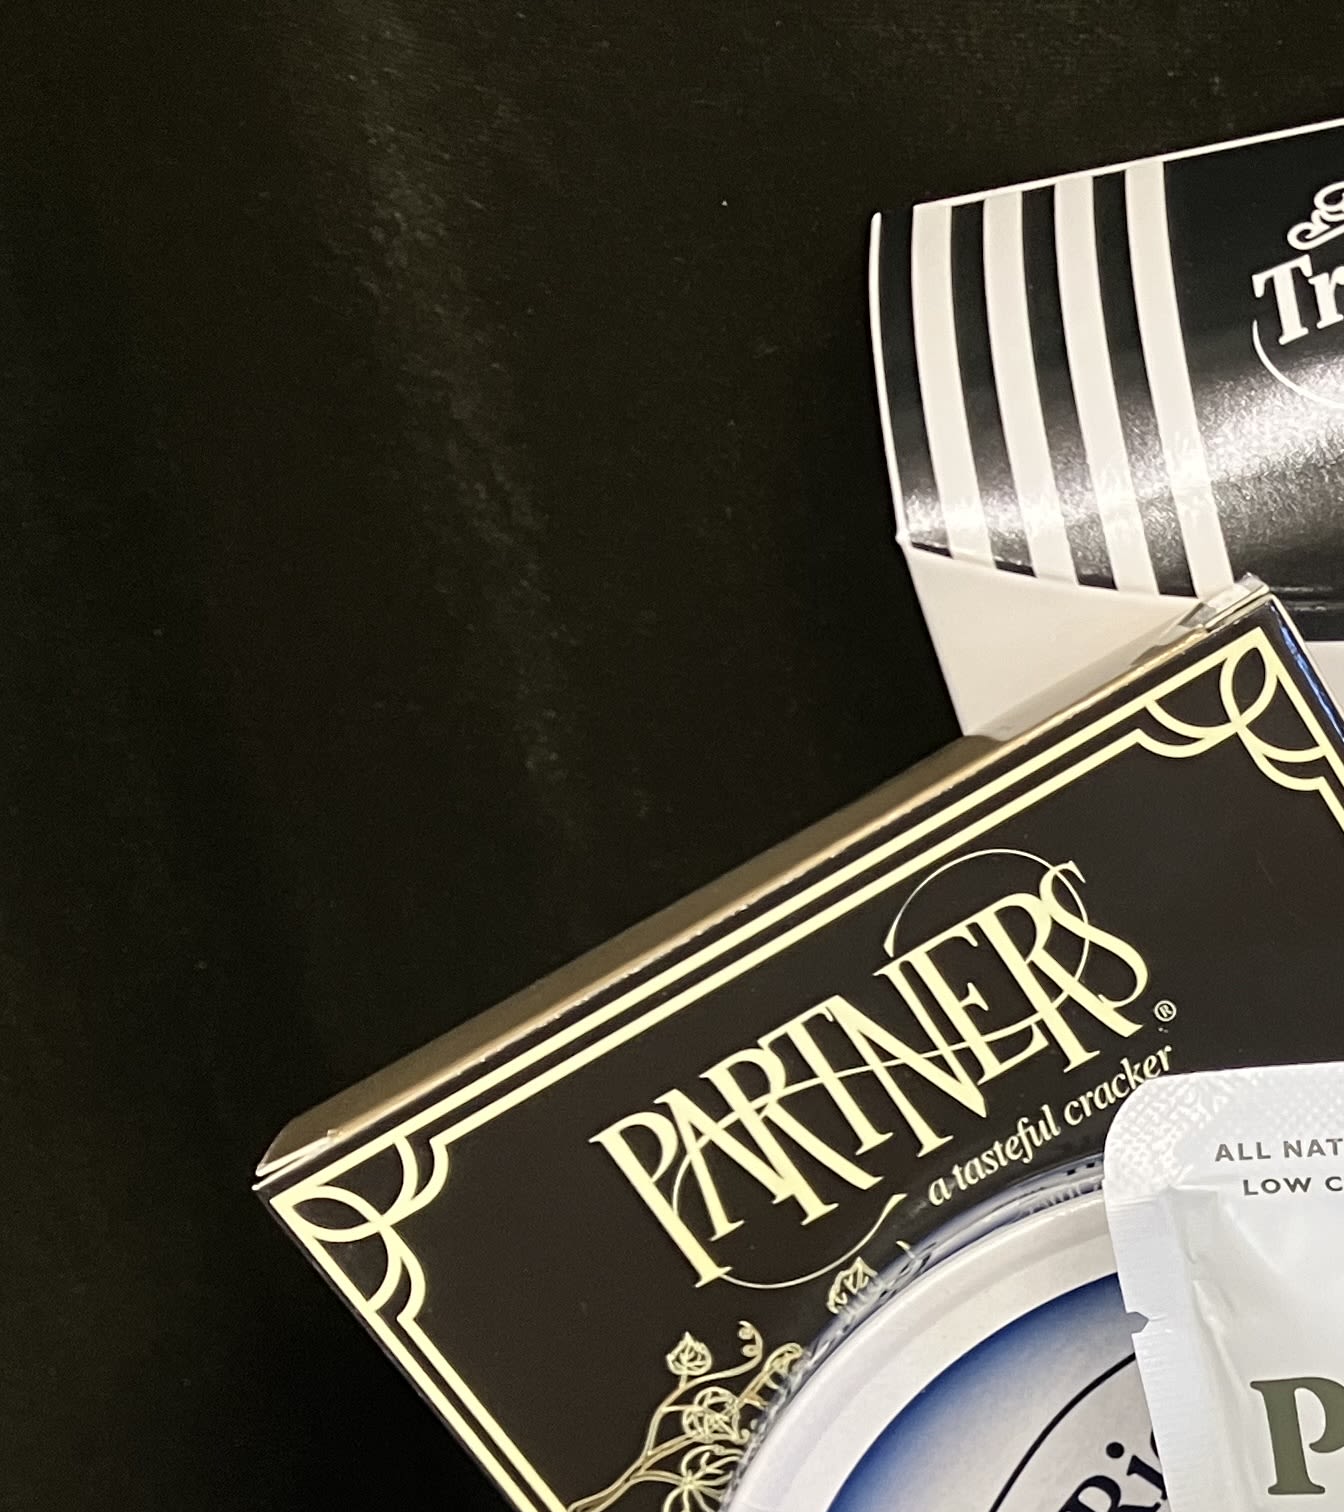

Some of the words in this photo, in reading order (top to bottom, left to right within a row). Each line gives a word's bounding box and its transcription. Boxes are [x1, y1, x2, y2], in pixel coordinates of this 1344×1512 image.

[589, 861, 1149, 1288] PARTNERS
[927, 1175, 956, 1206] a
[952, 1104, 1060, 1192] tasteful
[1064, 1045, 1174, 1127] cracker
[1215, 1137, 1273, 1163] ALL
[1242, 1174, 1312, 1196] LOW
